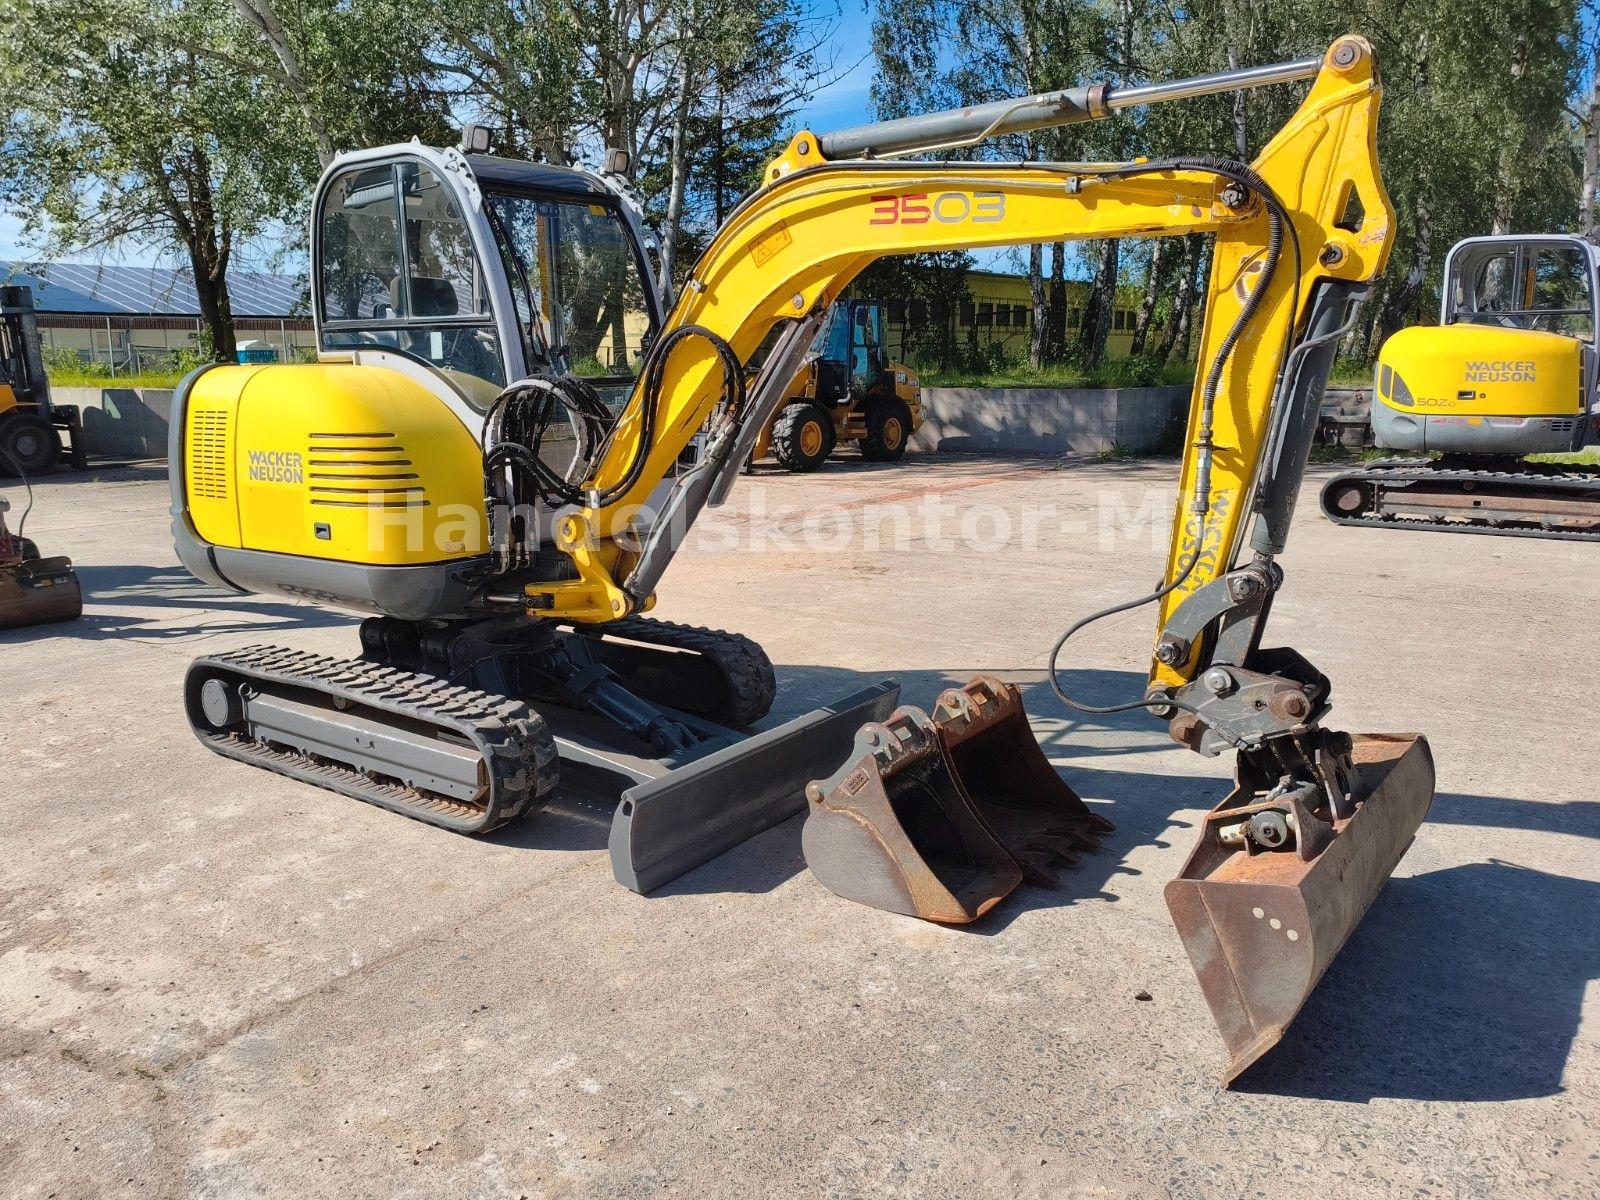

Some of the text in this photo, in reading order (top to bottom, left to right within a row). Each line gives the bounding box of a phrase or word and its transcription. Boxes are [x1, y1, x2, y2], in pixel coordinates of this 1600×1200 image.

[870, 191, 1006, 225] 3503
[1465, 361, 1537, 372] WACKER
[1465, 371, 1537, 383] NEUSON
[248, 449, 304, 468] WACKER
[248, 465, 304, 484] NEUSON
